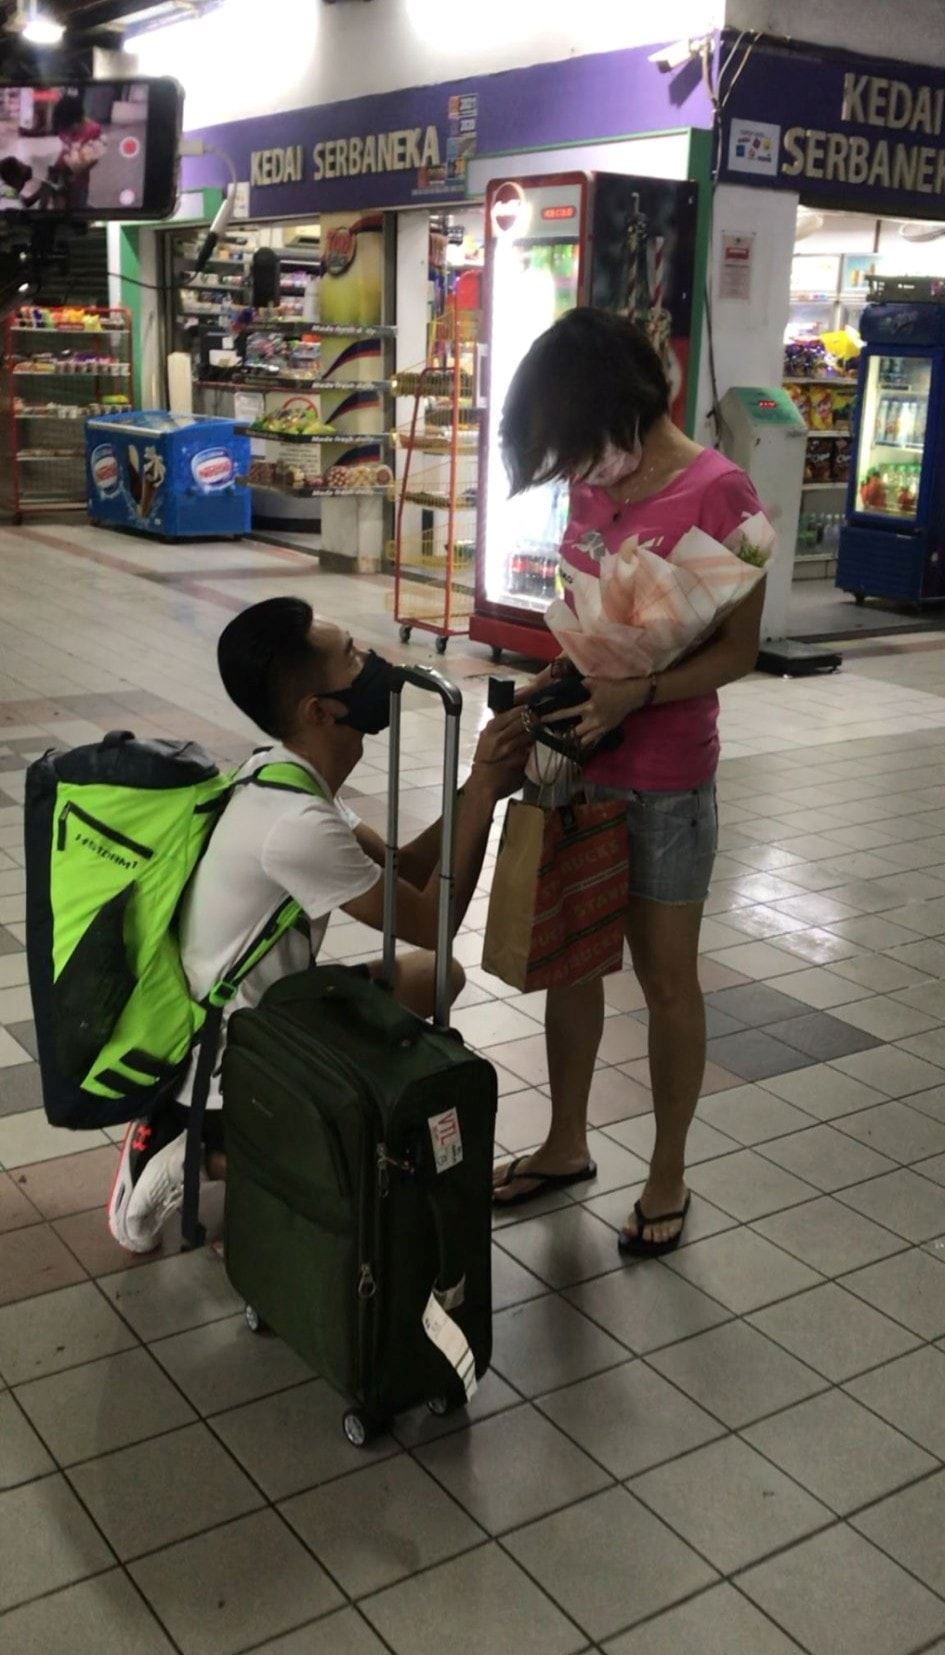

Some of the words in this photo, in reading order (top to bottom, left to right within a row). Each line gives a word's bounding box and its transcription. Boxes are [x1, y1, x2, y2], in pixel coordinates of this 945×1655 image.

[840, 72, 945, 135] KEDAI
[250, 146, 302, 186] KEDAI
[313, 126, 440, 180] SERBANEKA
[438, 1111, 457, 1146] VTL
